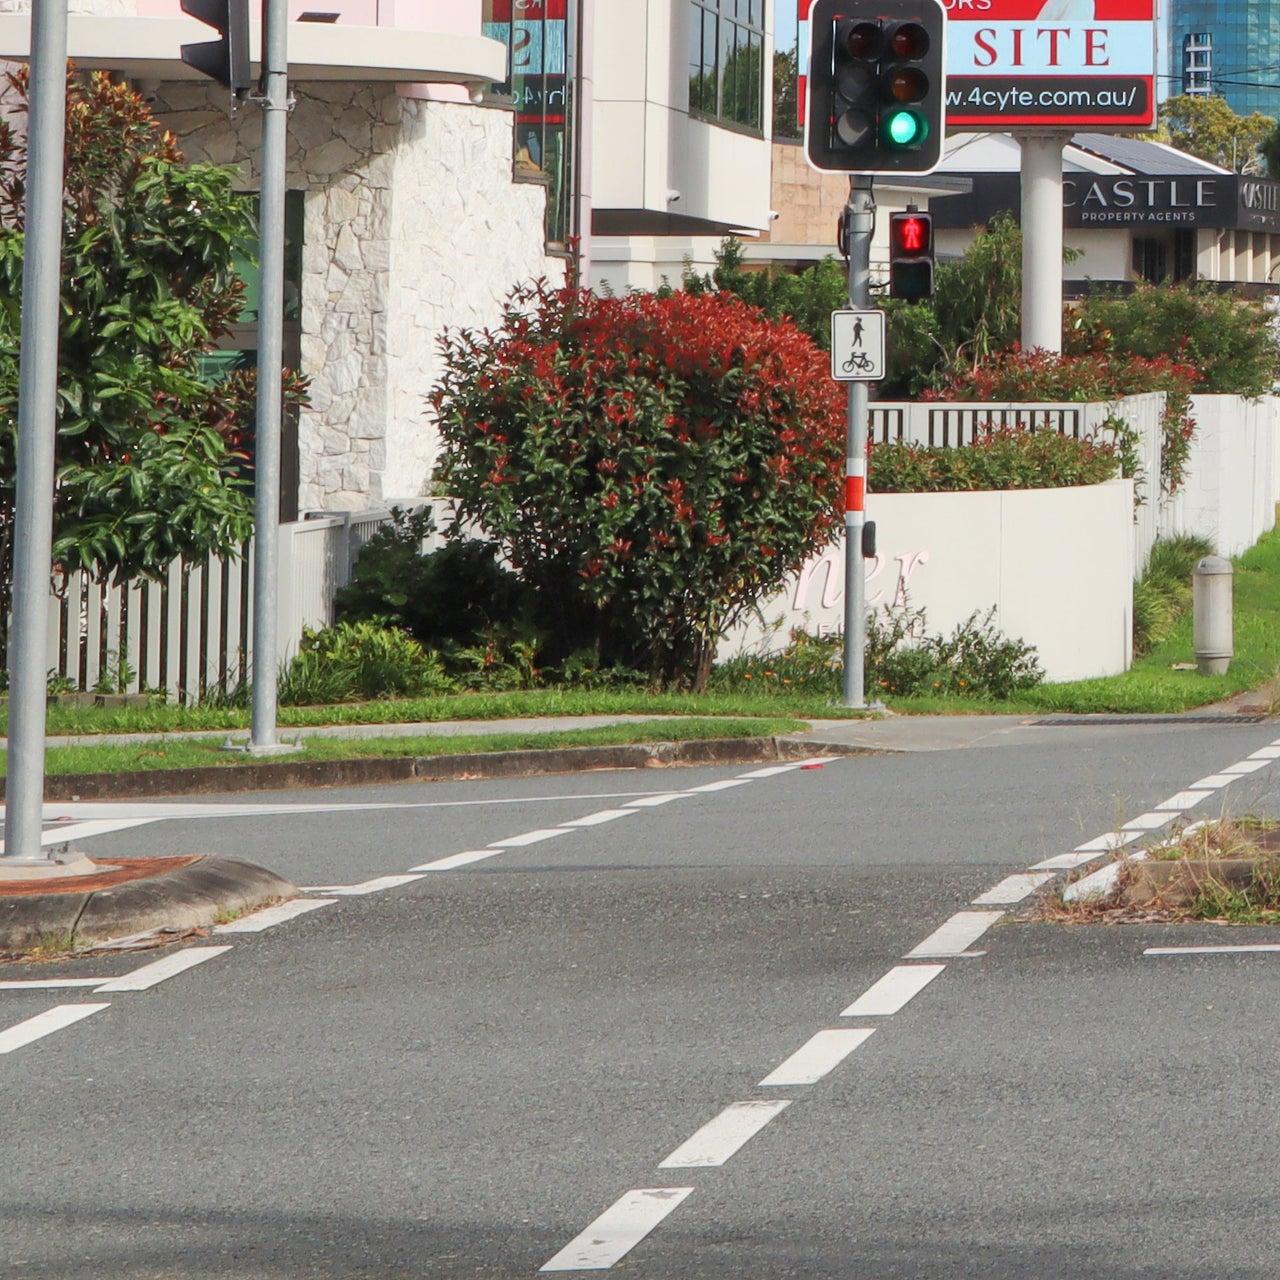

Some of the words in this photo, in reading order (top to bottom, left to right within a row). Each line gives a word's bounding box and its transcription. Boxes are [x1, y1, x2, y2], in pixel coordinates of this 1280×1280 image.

[973, 28, 1111, 67] SITE
[945, 86, 1137, 111] w.4cyte.com.au/
[1062, 180, 1217, 208] CASTLE
[1082, 211, 1144, 221] PROPERTY
[1147, 211, 1196, 221] AGENTS
